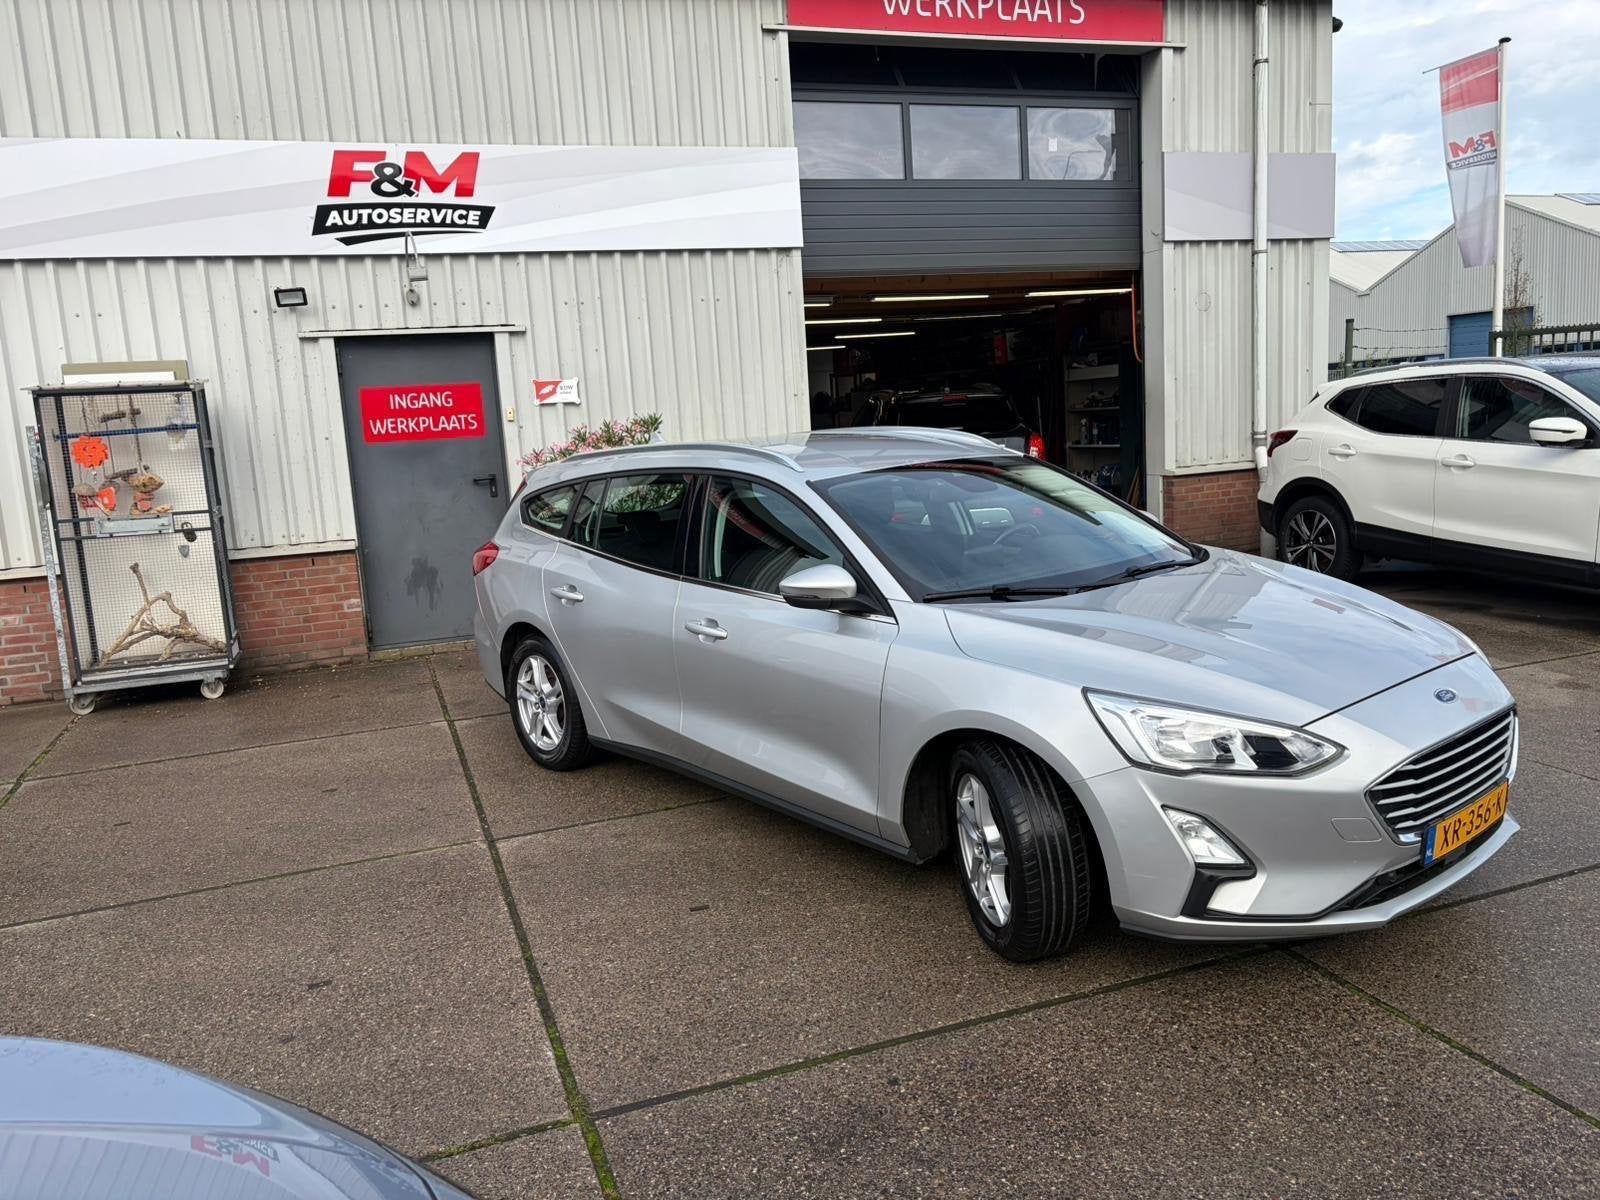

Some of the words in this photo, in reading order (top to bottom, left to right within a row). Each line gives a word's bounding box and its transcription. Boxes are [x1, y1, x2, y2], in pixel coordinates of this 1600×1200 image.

[882, 0, 1085, 24] WERKPLAATS
[327, 150, 480, 198] F&M
[325, 208, 481, 226] AUTOSERVICE
[389, 391, 453, 410] INGANG
[369, 414, 478, 435] WERKPLAATS
[1441, 789, 1504, 851] XR-356-K
